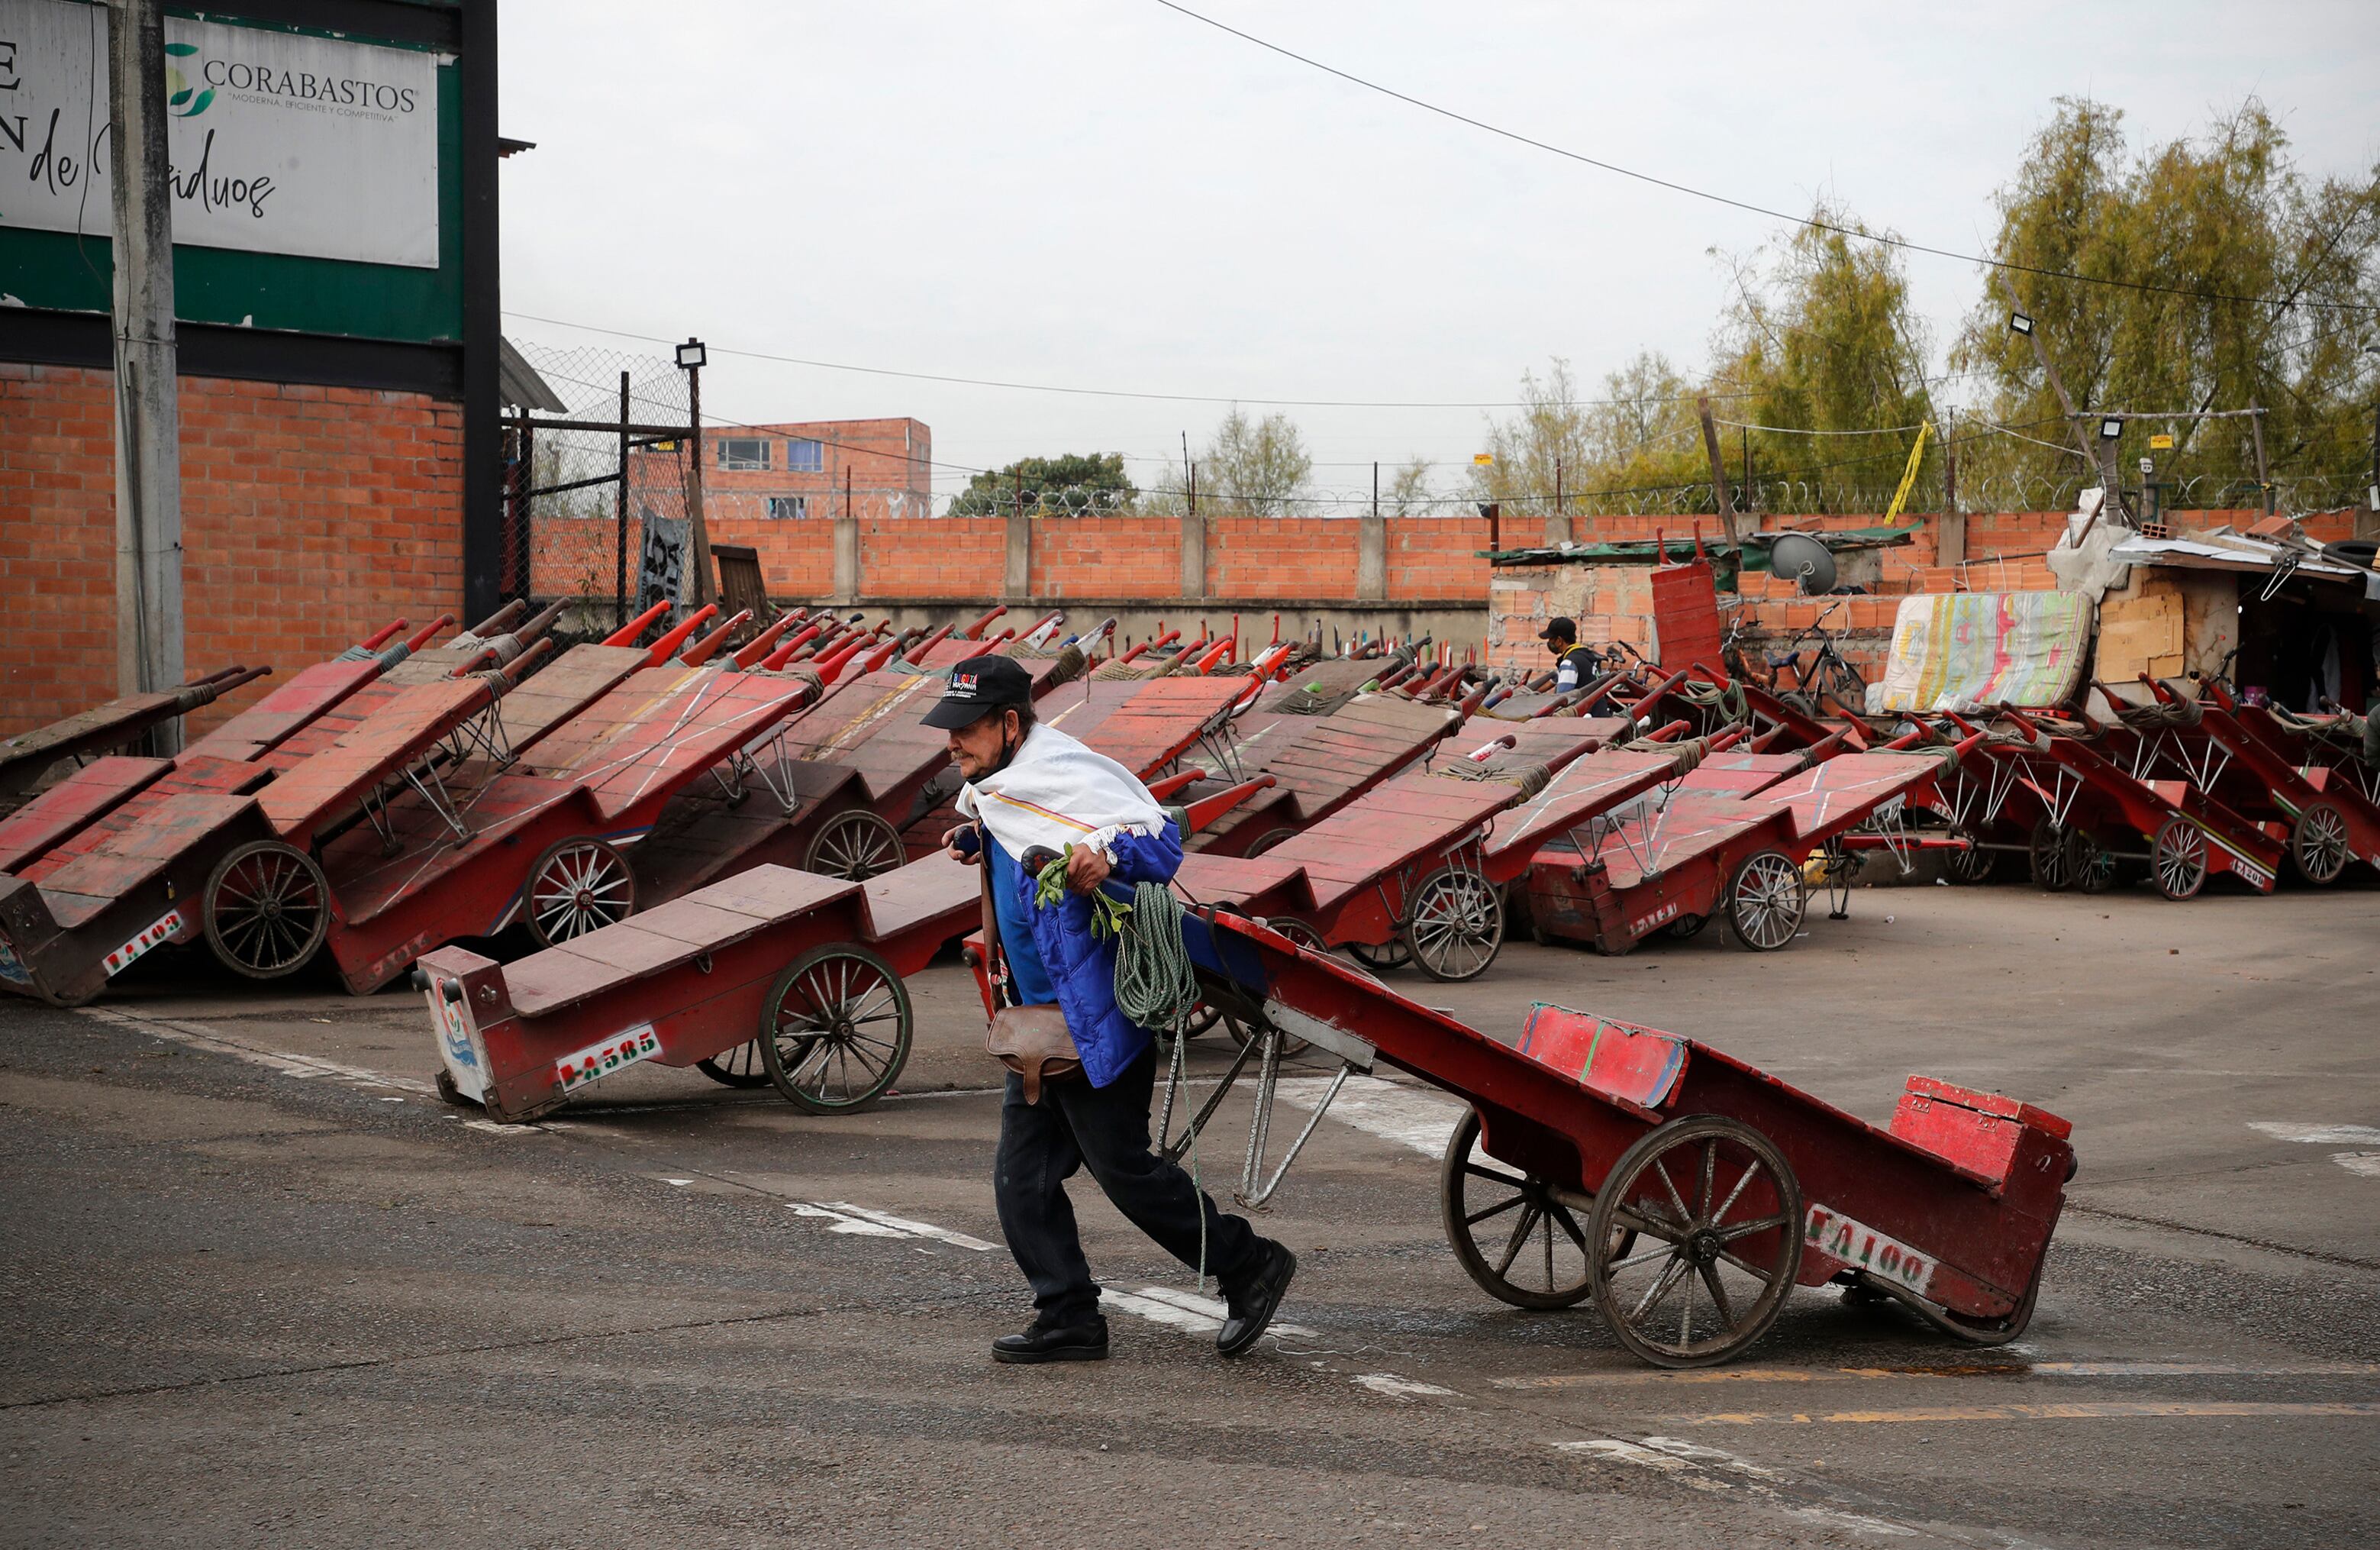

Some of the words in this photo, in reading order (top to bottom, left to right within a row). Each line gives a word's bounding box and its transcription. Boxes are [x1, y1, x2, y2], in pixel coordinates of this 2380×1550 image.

[204, 60, 414, 113] CORABASTOS
[285, 100, 328, 114] EFICIENTE
[329, 106, 334, 115] Y
[29, 107, 79, 197] de
